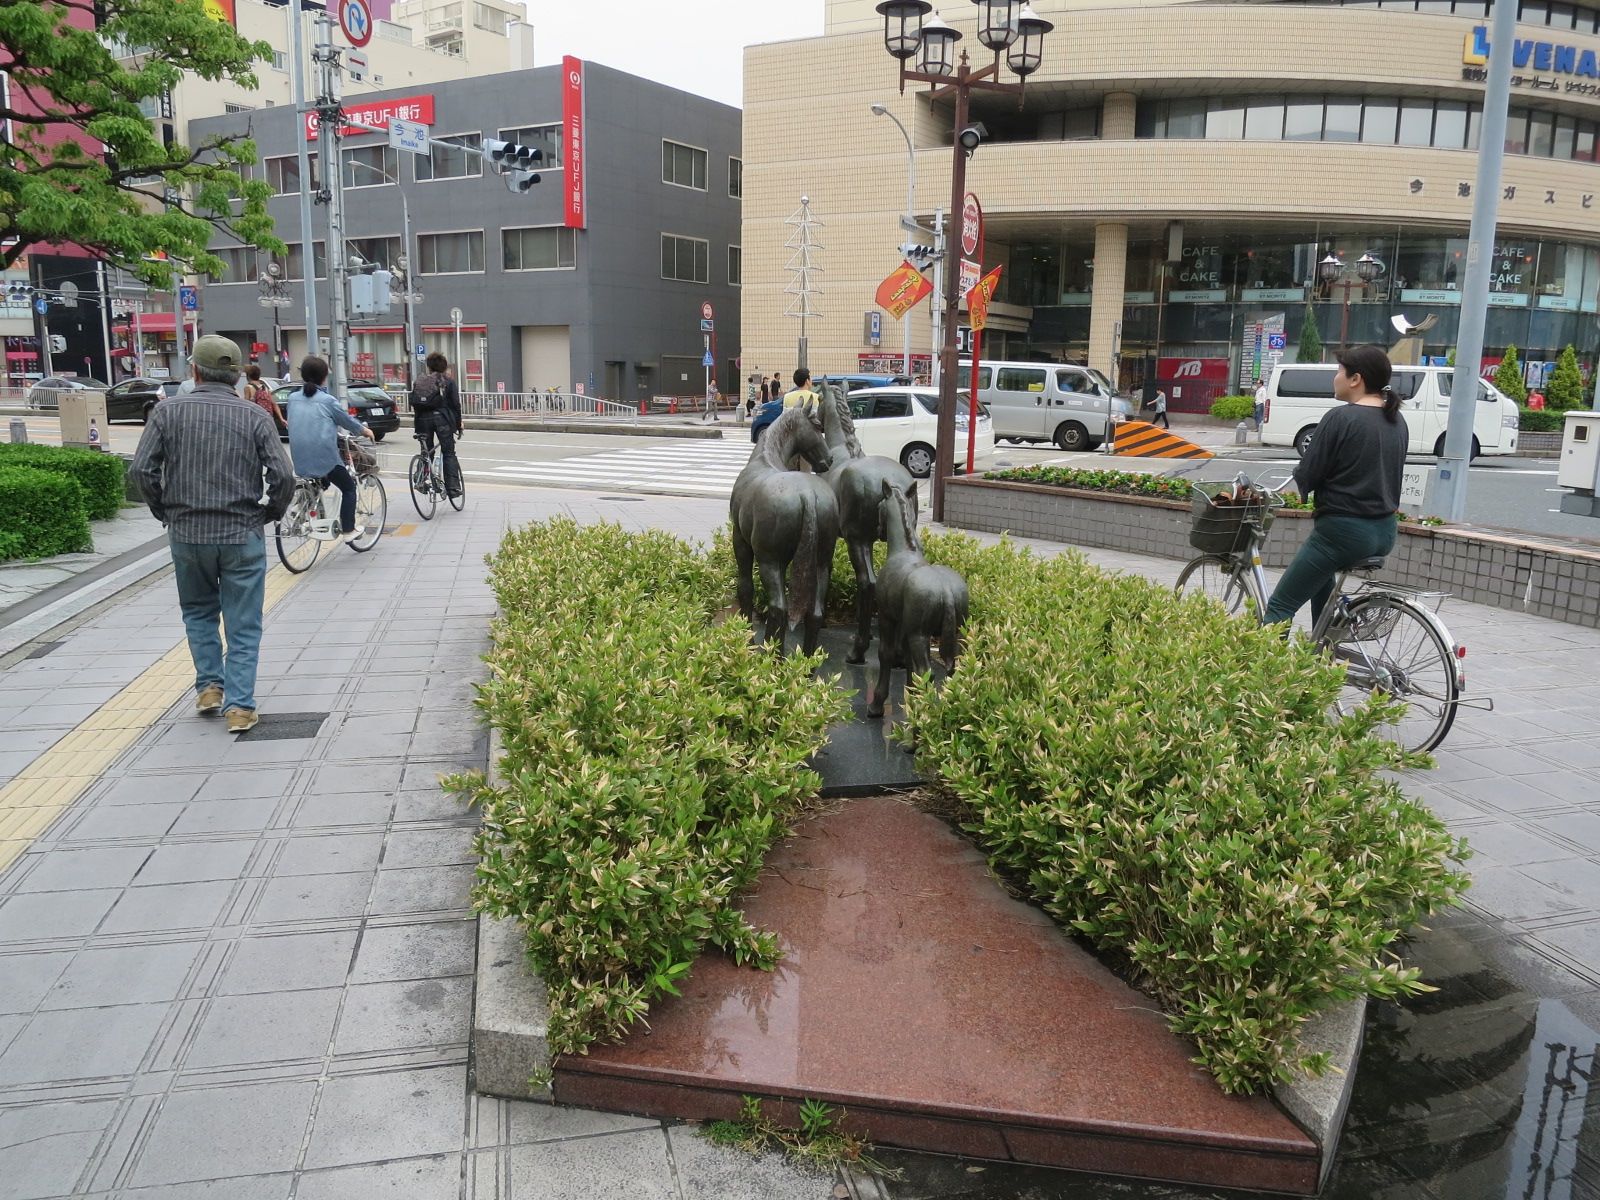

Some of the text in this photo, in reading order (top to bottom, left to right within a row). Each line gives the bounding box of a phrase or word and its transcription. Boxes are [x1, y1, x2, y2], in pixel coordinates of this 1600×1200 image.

[394, 123, 424, 141] 今池
[400, 138, 419, 149] Imaike
[1182, 246, 1219, 257] CAFE
[1493, 246, 1526, 259] CAFE
[1194, 259, 1204, 269] &
[1502, 260, 1512, 271] &
[1180, 271, 1218, 282] CAKE
[1489, 272, 1523, 284] CAKE
[1173, 360, 1202, 378] JTB
